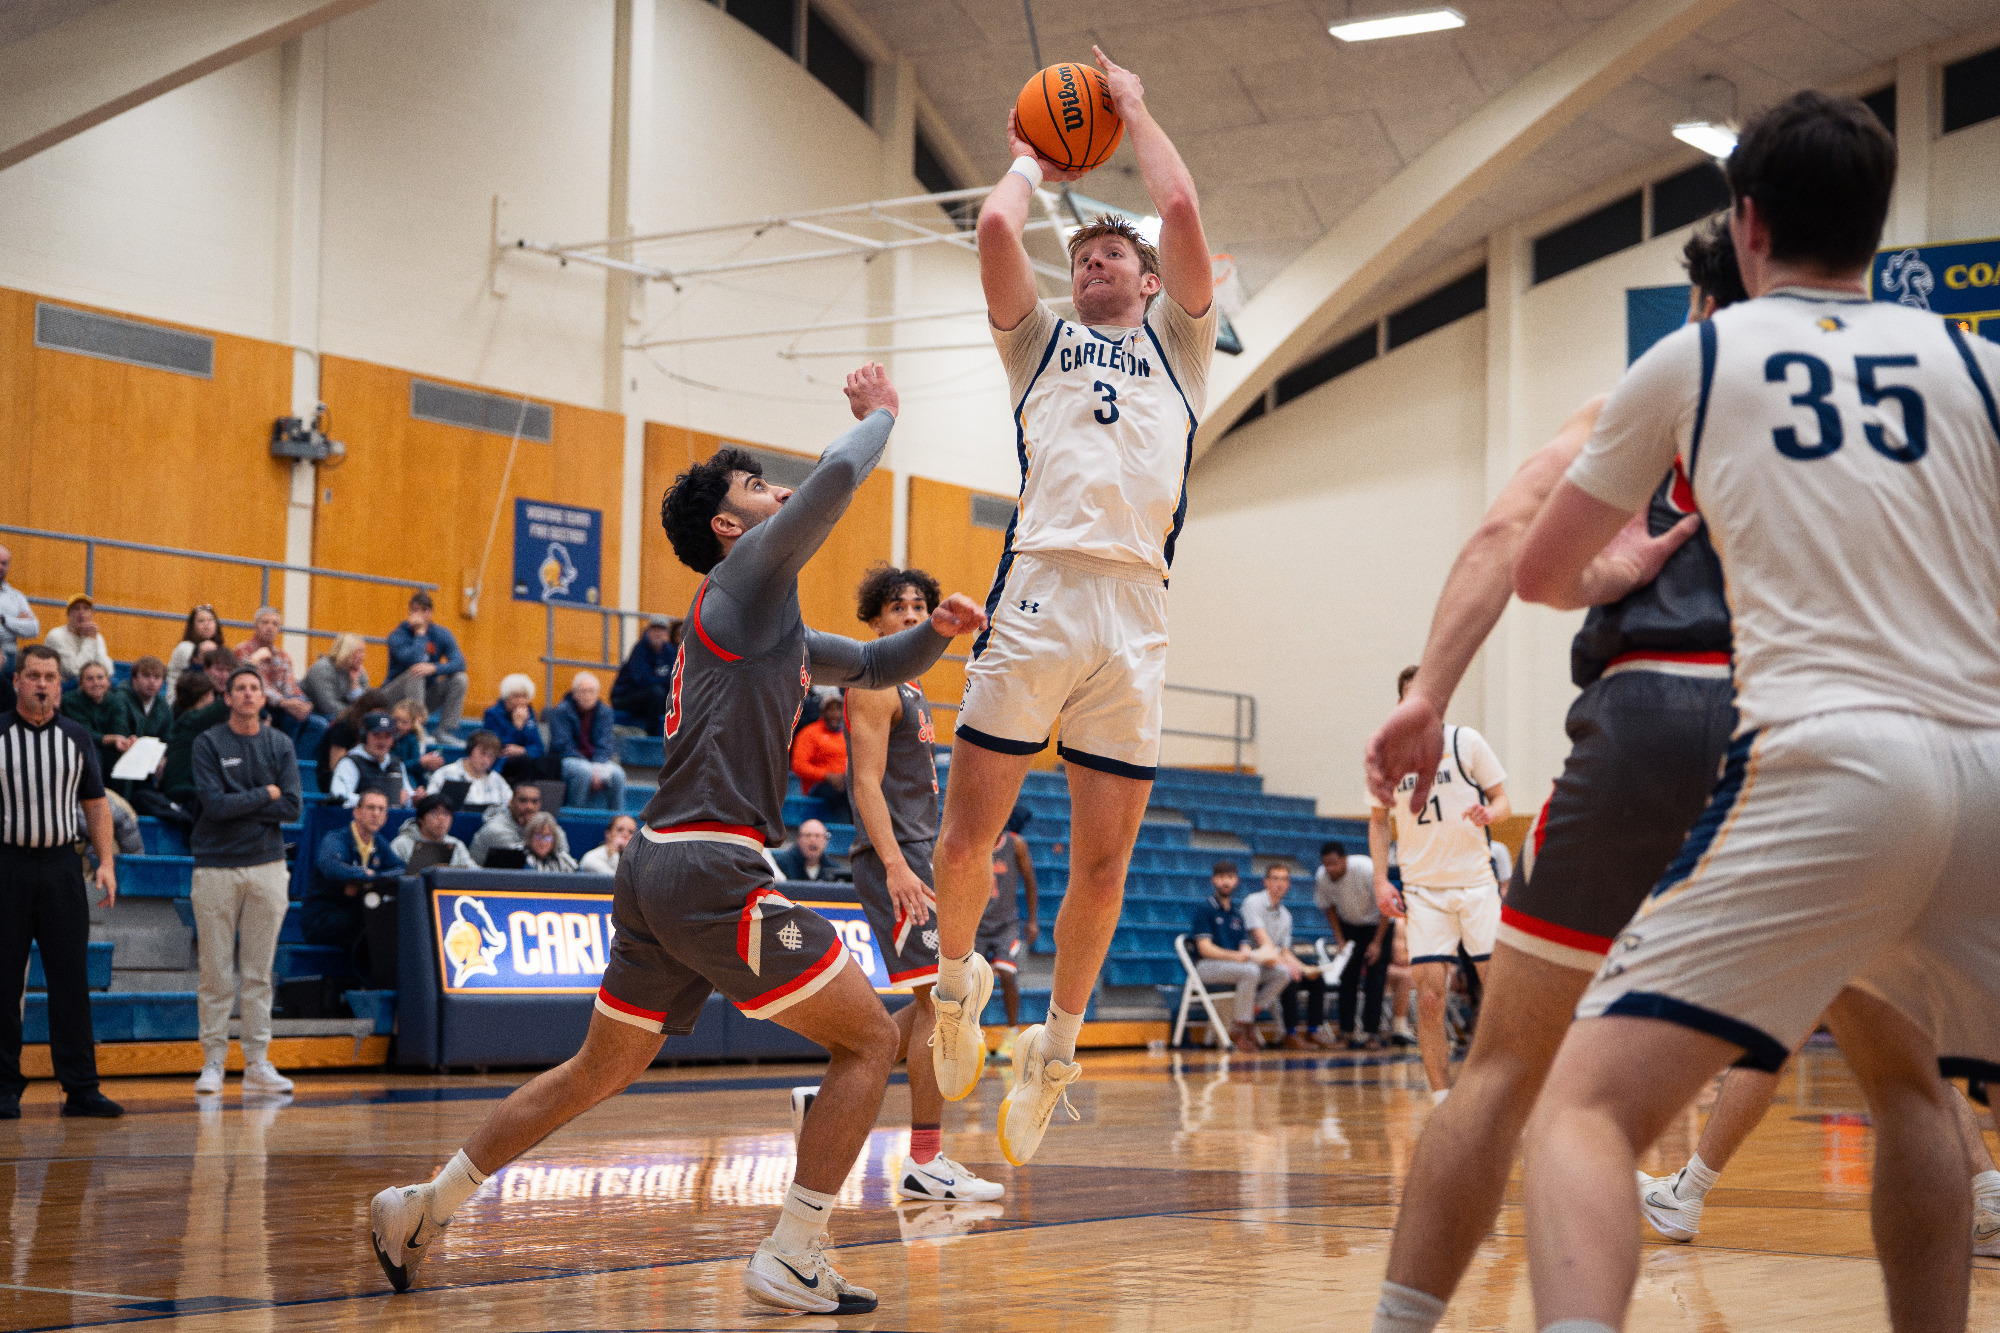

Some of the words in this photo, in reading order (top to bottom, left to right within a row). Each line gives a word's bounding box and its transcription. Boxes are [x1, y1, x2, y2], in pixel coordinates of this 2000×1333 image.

[1057, 66, 1084, 133] Wilson
[1093, 380, 1120, 425] 3
[1764, 351, 1929, 464] 35
